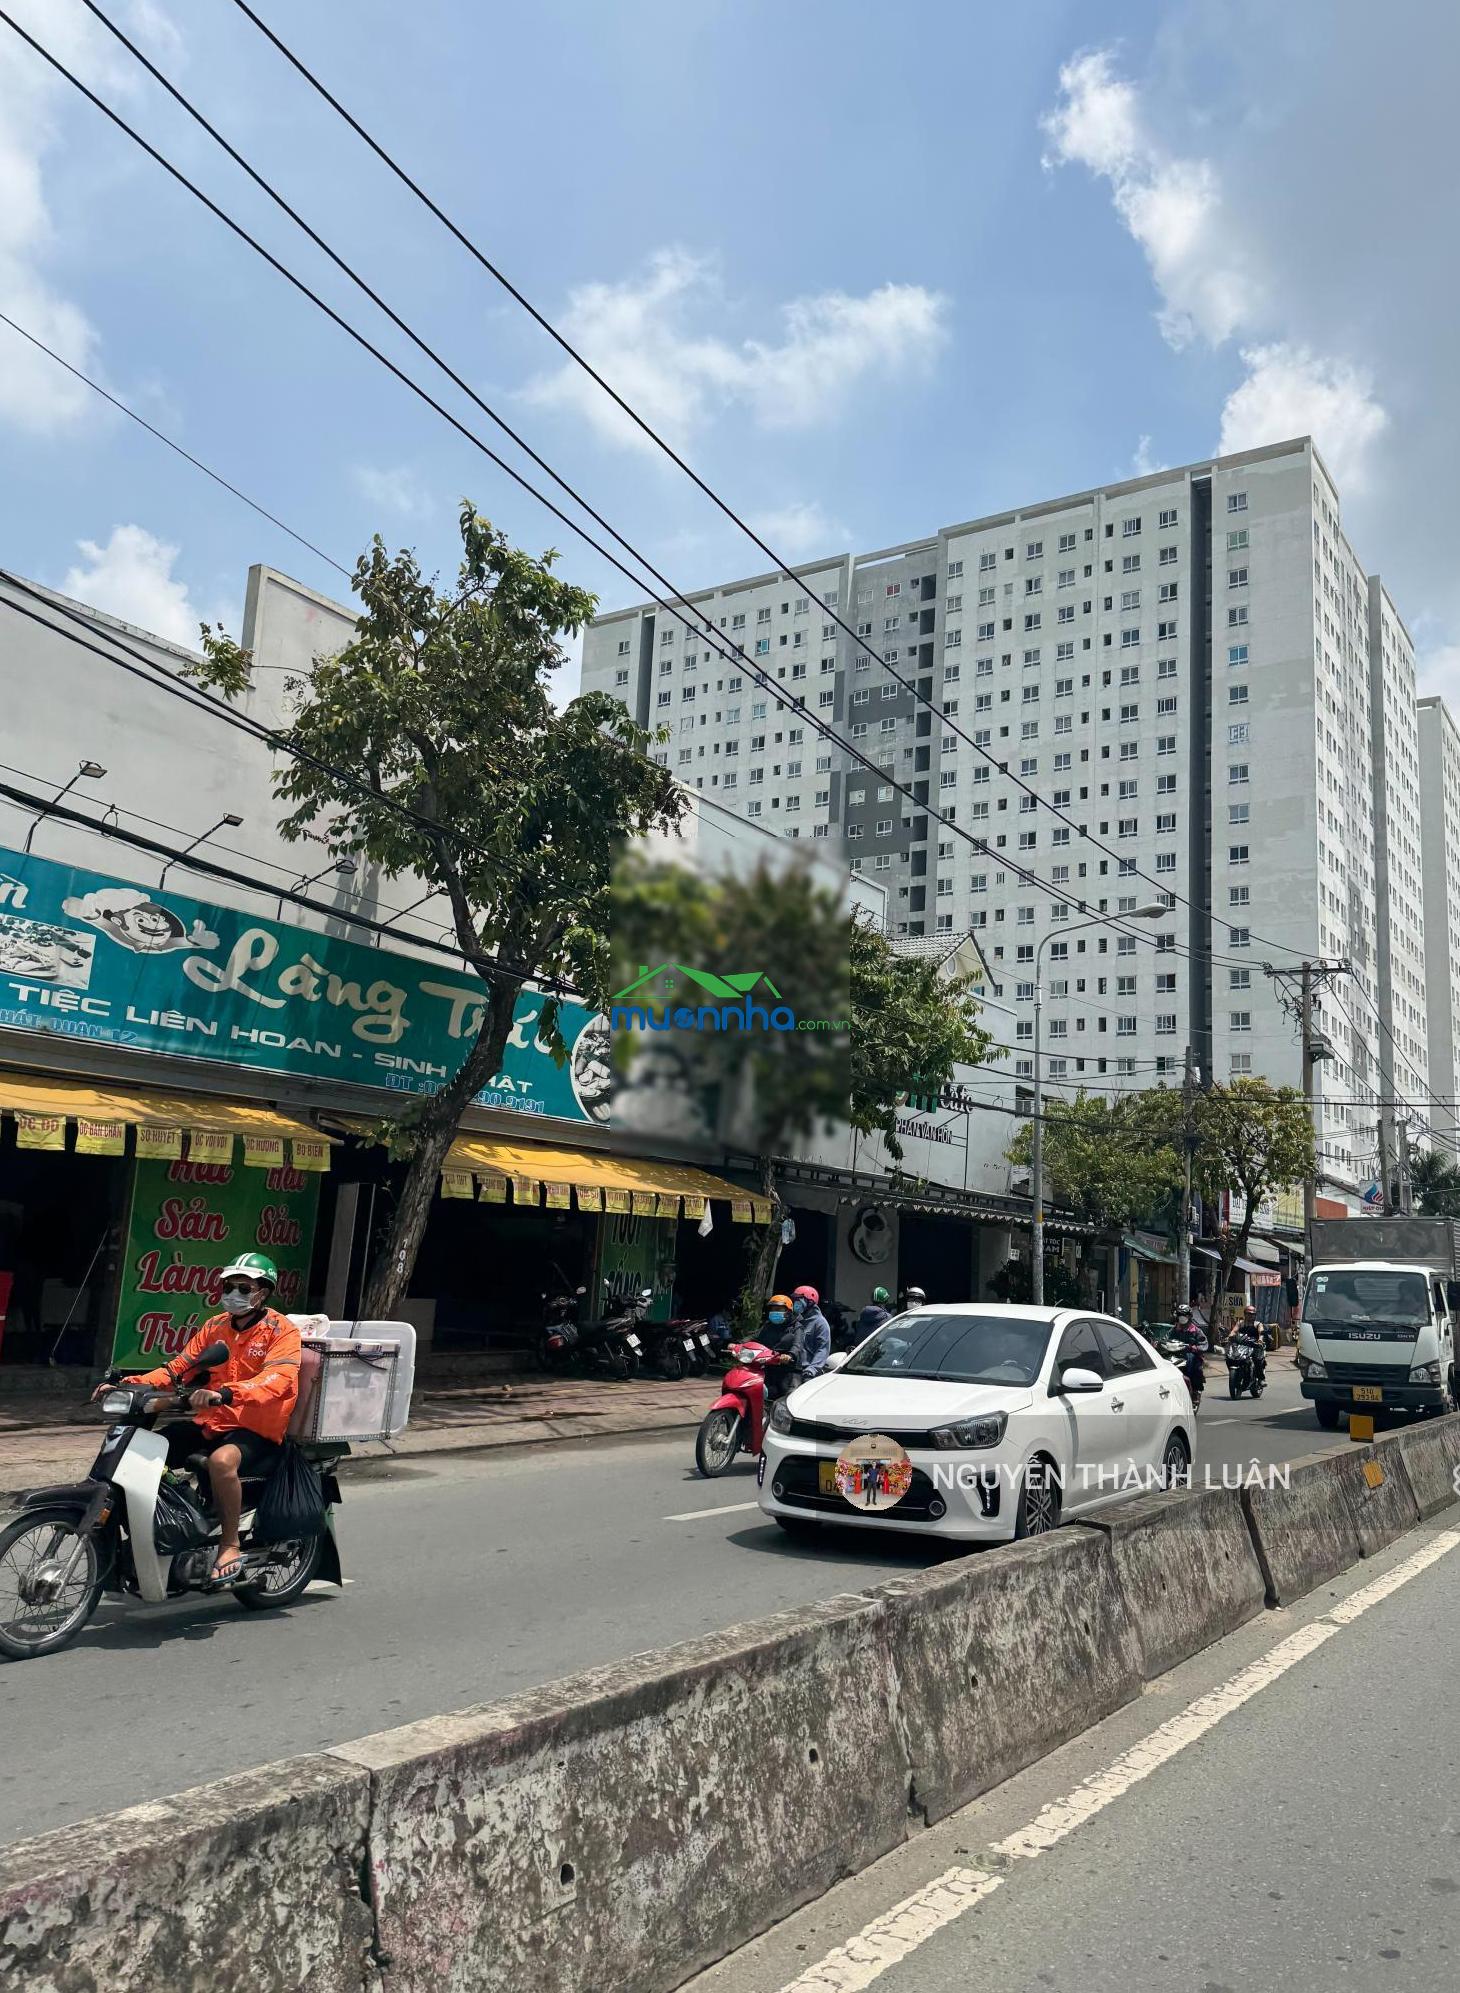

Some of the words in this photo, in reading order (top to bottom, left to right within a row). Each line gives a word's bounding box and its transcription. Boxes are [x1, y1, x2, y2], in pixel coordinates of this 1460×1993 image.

[9, 982, 111, 1016] TIỆC
[126, 1005, 217, 1036] LIÊN
[231, 1025, 341, 1058] HOAN
[374, 1052, 446, 1078] SINH
[155, 1197, 231, 1242] Sản
[136, 1250, 225, 1308] Làng
[136, 1311, 204, 1356] Trú
[1348, 1332, 1381, 1340] ISUZU
